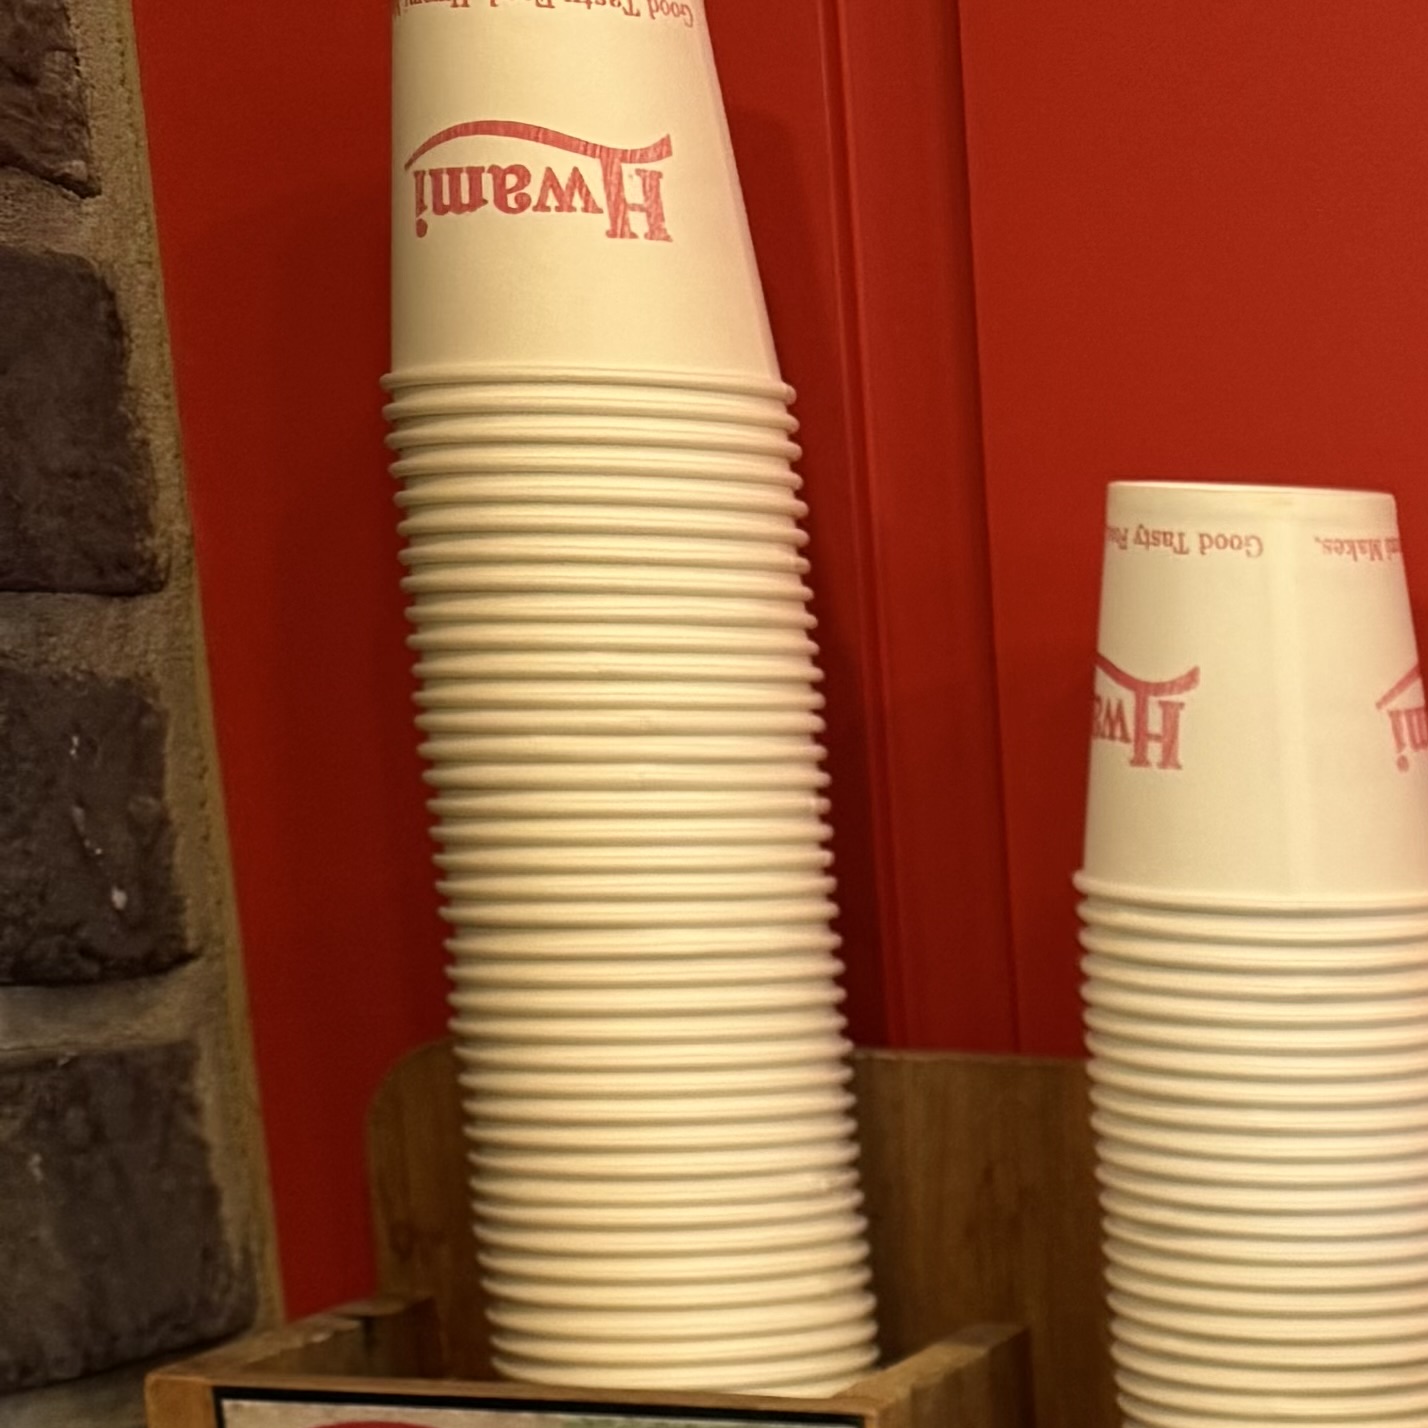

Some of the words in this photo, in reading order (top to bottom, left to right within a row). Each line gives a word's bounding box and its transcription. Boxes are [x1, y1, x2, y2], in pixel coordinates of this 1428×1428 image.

[405, 135, 674, 242] Hwami
[1133, 524, 1190, 555] Tasty
[1199, 532, 1263, 558] Good
